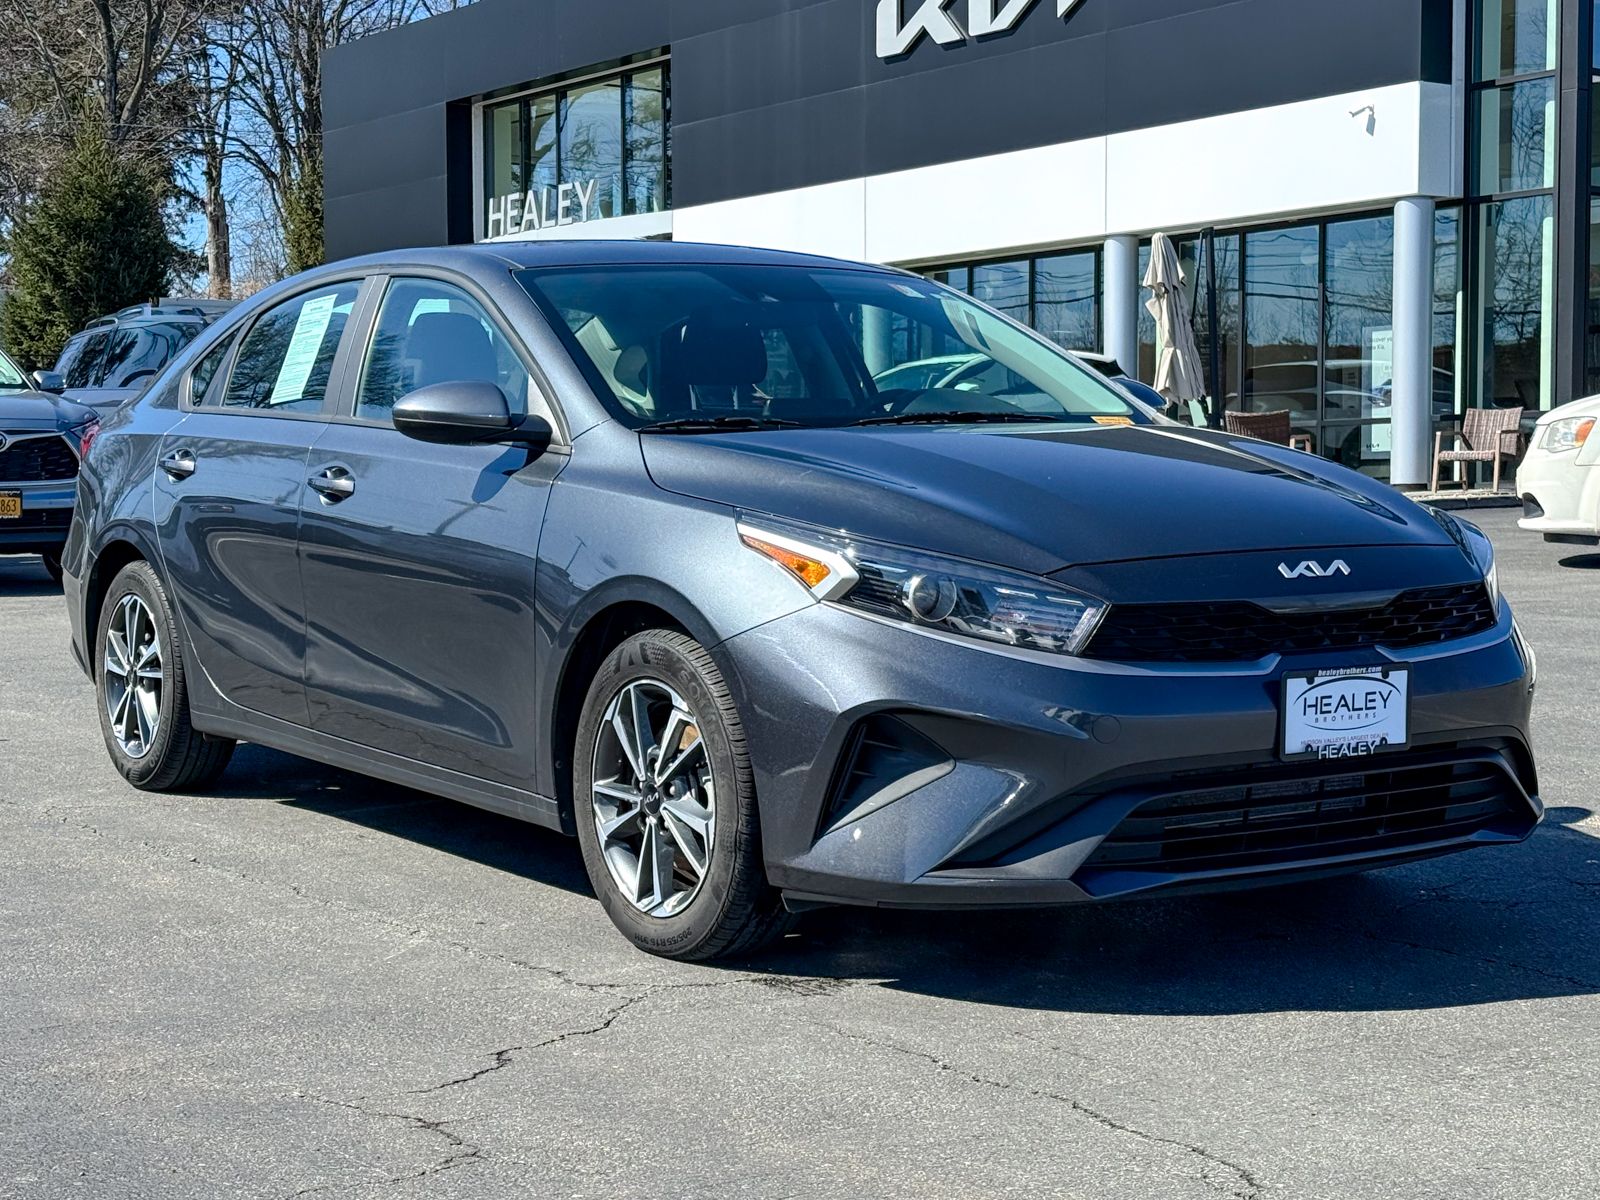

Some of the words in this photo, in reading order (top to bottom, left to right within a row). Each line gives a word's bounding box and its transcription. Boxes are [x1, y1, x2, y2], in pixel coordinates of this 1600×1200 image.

[488, 178, 595, 240] HEALEY
[1278, 559, 1351, 578] KIA
[1318, 666, 1382, 677] healeybrothers.com
[1303, 690, 1392, 716] HEALEY
[1314, 712, 1377, 723] BROTHERS
[1318, 740, 1377, 760] HEALEY
